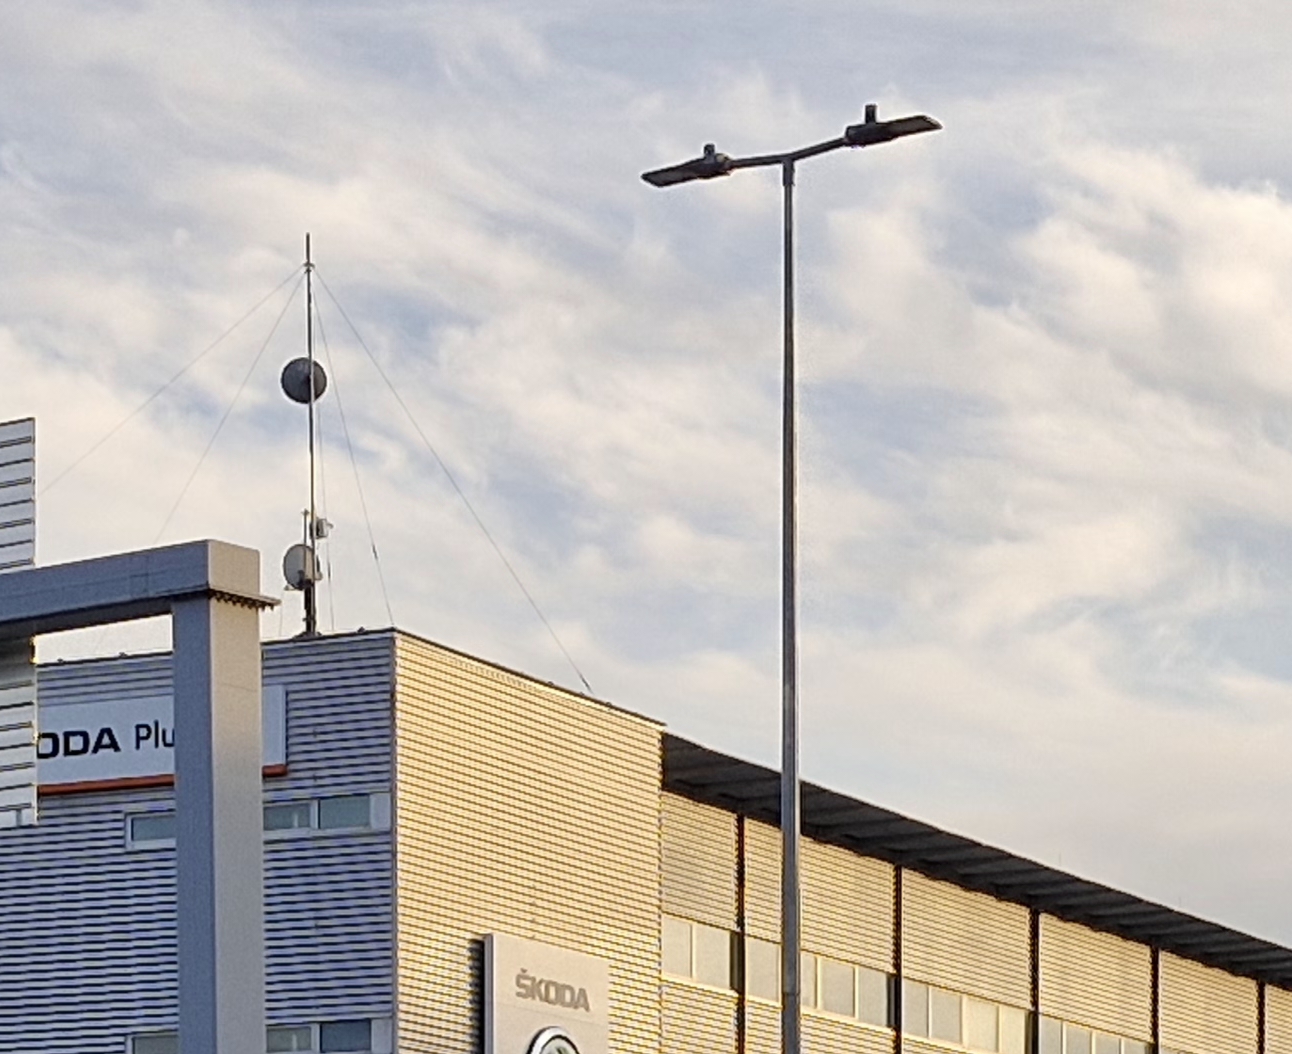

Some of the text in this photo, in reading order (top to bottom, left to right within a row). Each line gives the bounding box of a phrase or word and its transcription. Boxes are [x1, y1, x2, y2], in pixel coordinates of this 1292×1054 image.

[36, 720, 175, 759] ODA Plu
[515, 968, 590, 1012] ŠKODA
